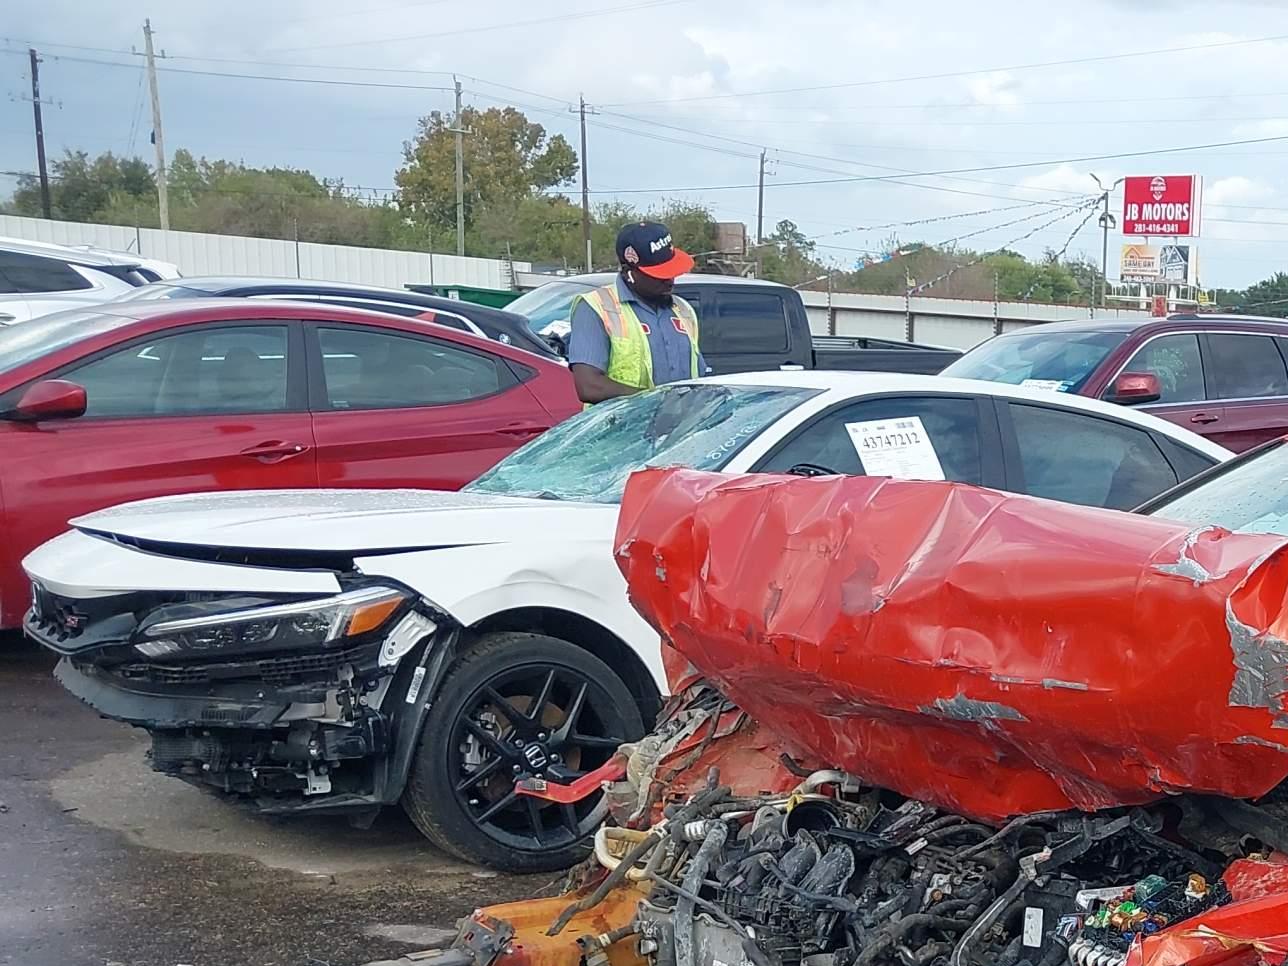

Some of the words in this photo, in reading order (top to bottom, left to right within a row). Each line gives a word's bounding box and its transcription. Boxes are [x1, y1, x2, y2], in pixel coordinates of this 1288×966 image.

[1125, 203, 1139, 221] JB
[1142, 203, 1190, 221] MOTORS
[1134, 223, 1179, 233] 281-416-4341
[862, 431, 921, 449] 43747212
